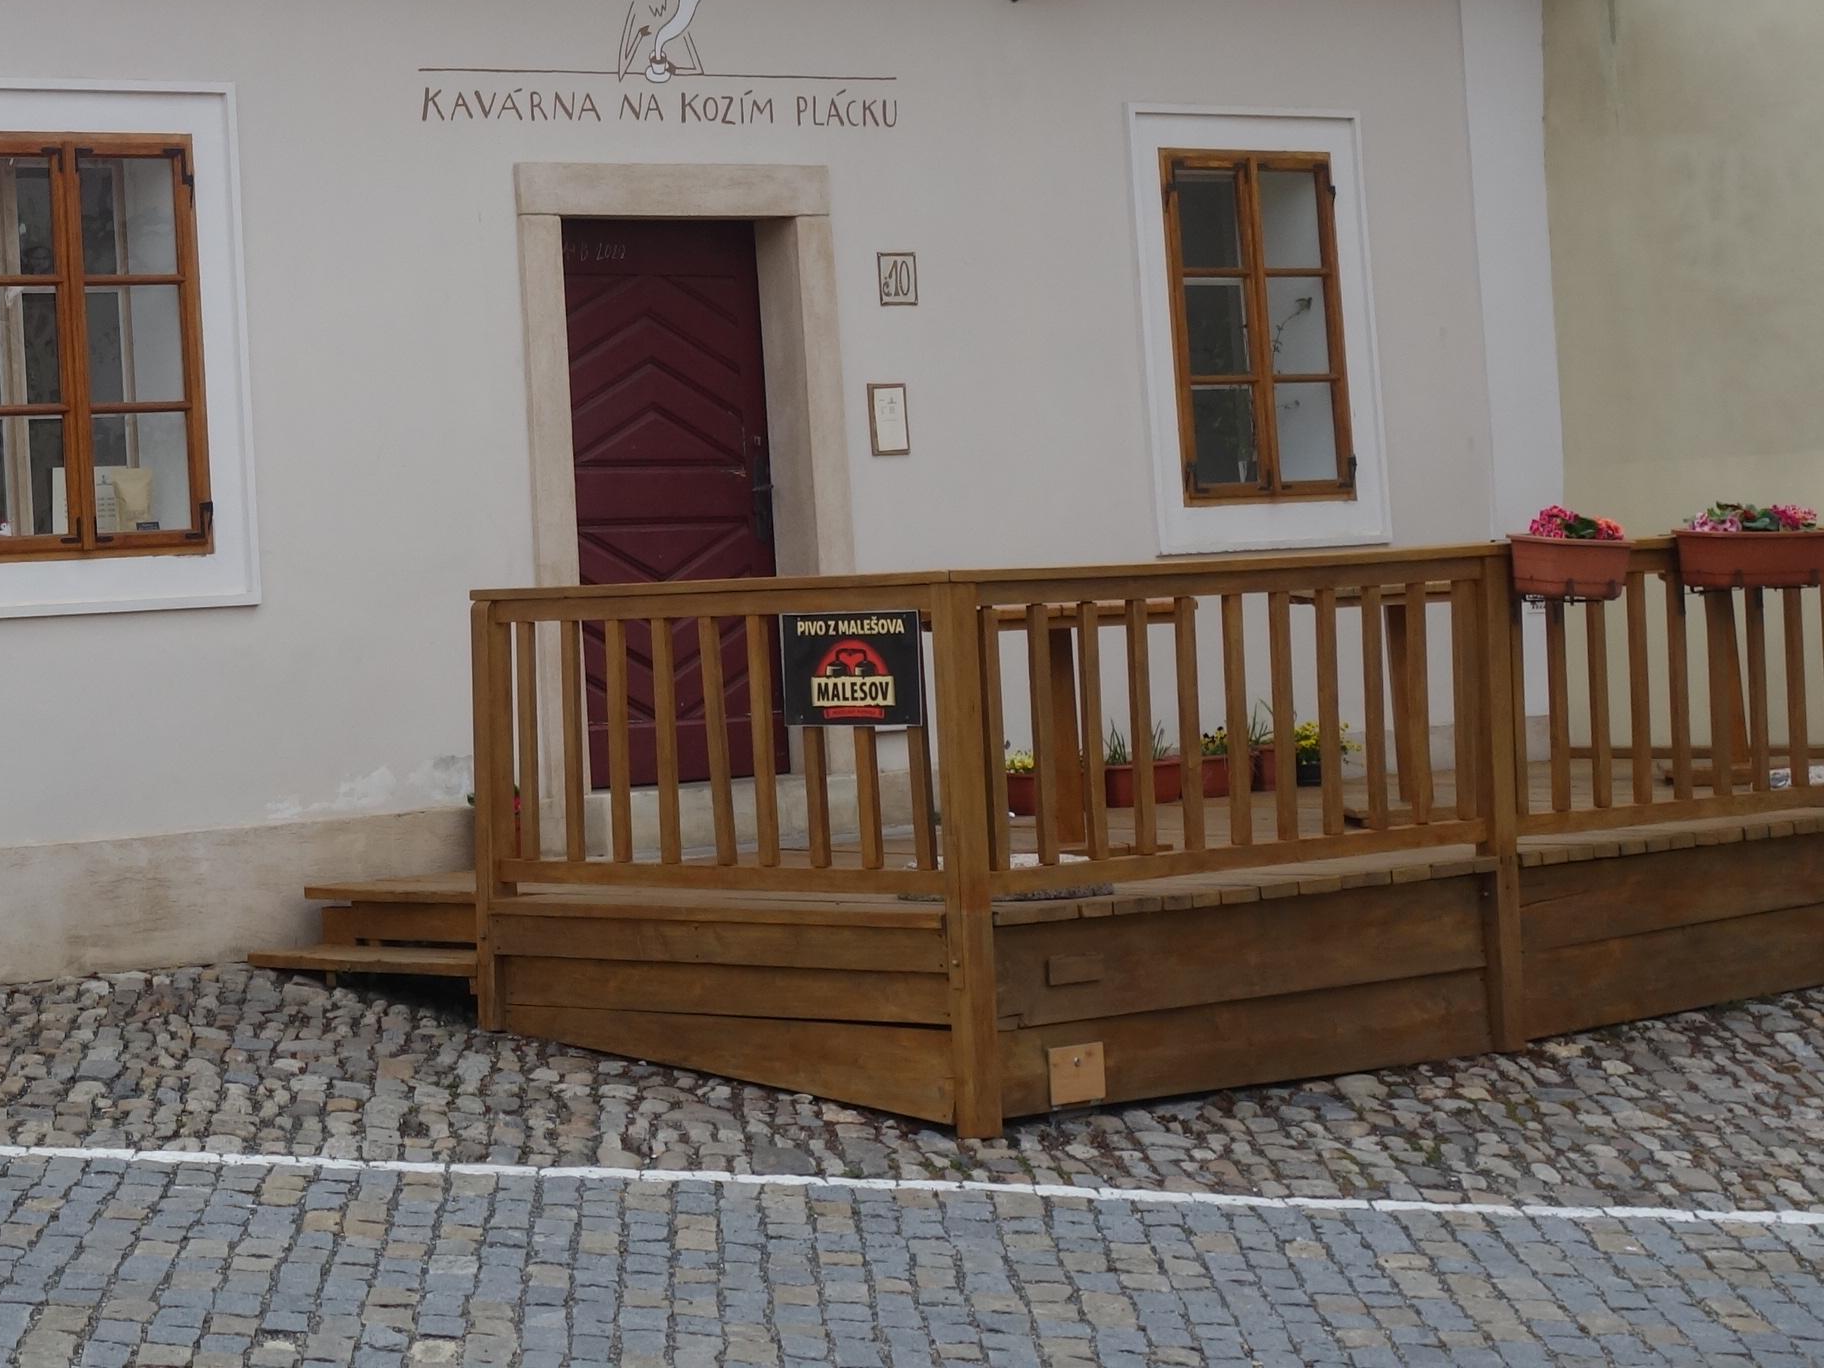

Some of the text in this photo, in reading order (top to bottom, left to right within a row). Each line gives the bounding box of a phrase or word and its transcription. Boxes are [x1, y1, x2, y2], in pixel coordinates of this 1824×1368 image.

[421, 86, 898, 128] KAVÁRNA NA KOZÍM PLÁCKU
[797, 615, 905, 636] PIVO Z MALEŠOVA
